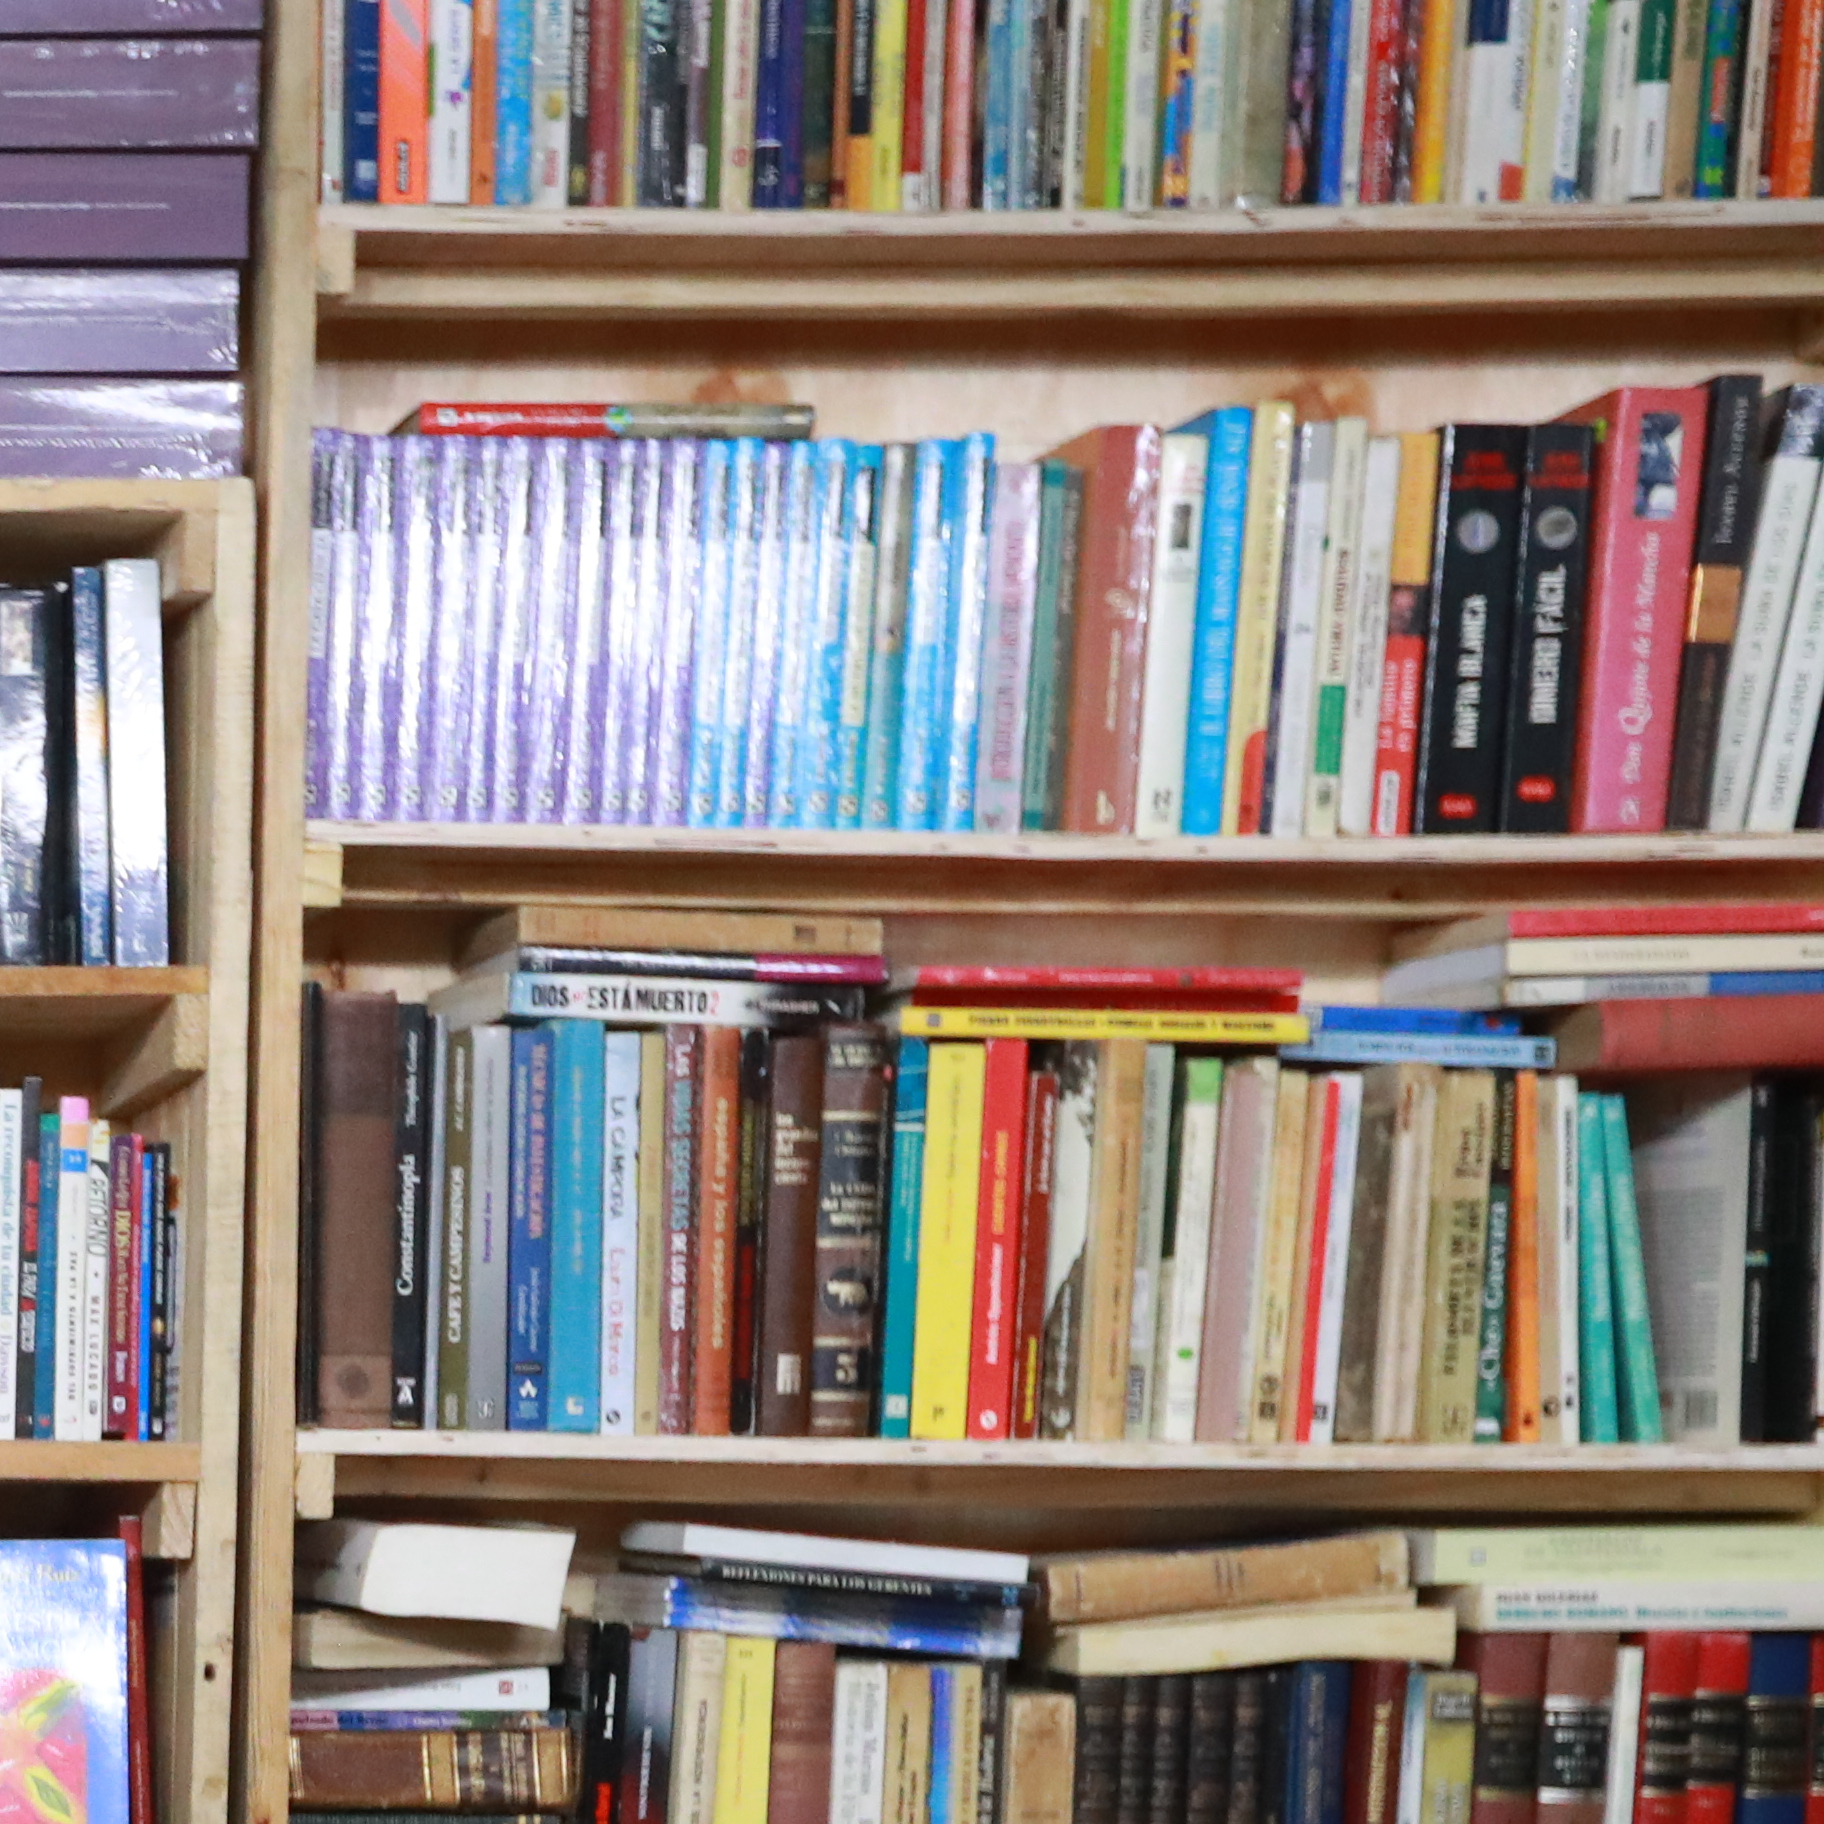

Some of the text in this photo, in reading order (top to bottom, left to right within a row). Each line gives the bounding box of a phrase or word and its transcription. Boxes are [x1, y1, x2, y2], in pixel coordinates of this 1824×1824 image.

[531, 985, 569, 1006] DIOS
[637, 987, 707, 1012] MUERTO
[396, 1154, 420, 1295] Constantinopla
